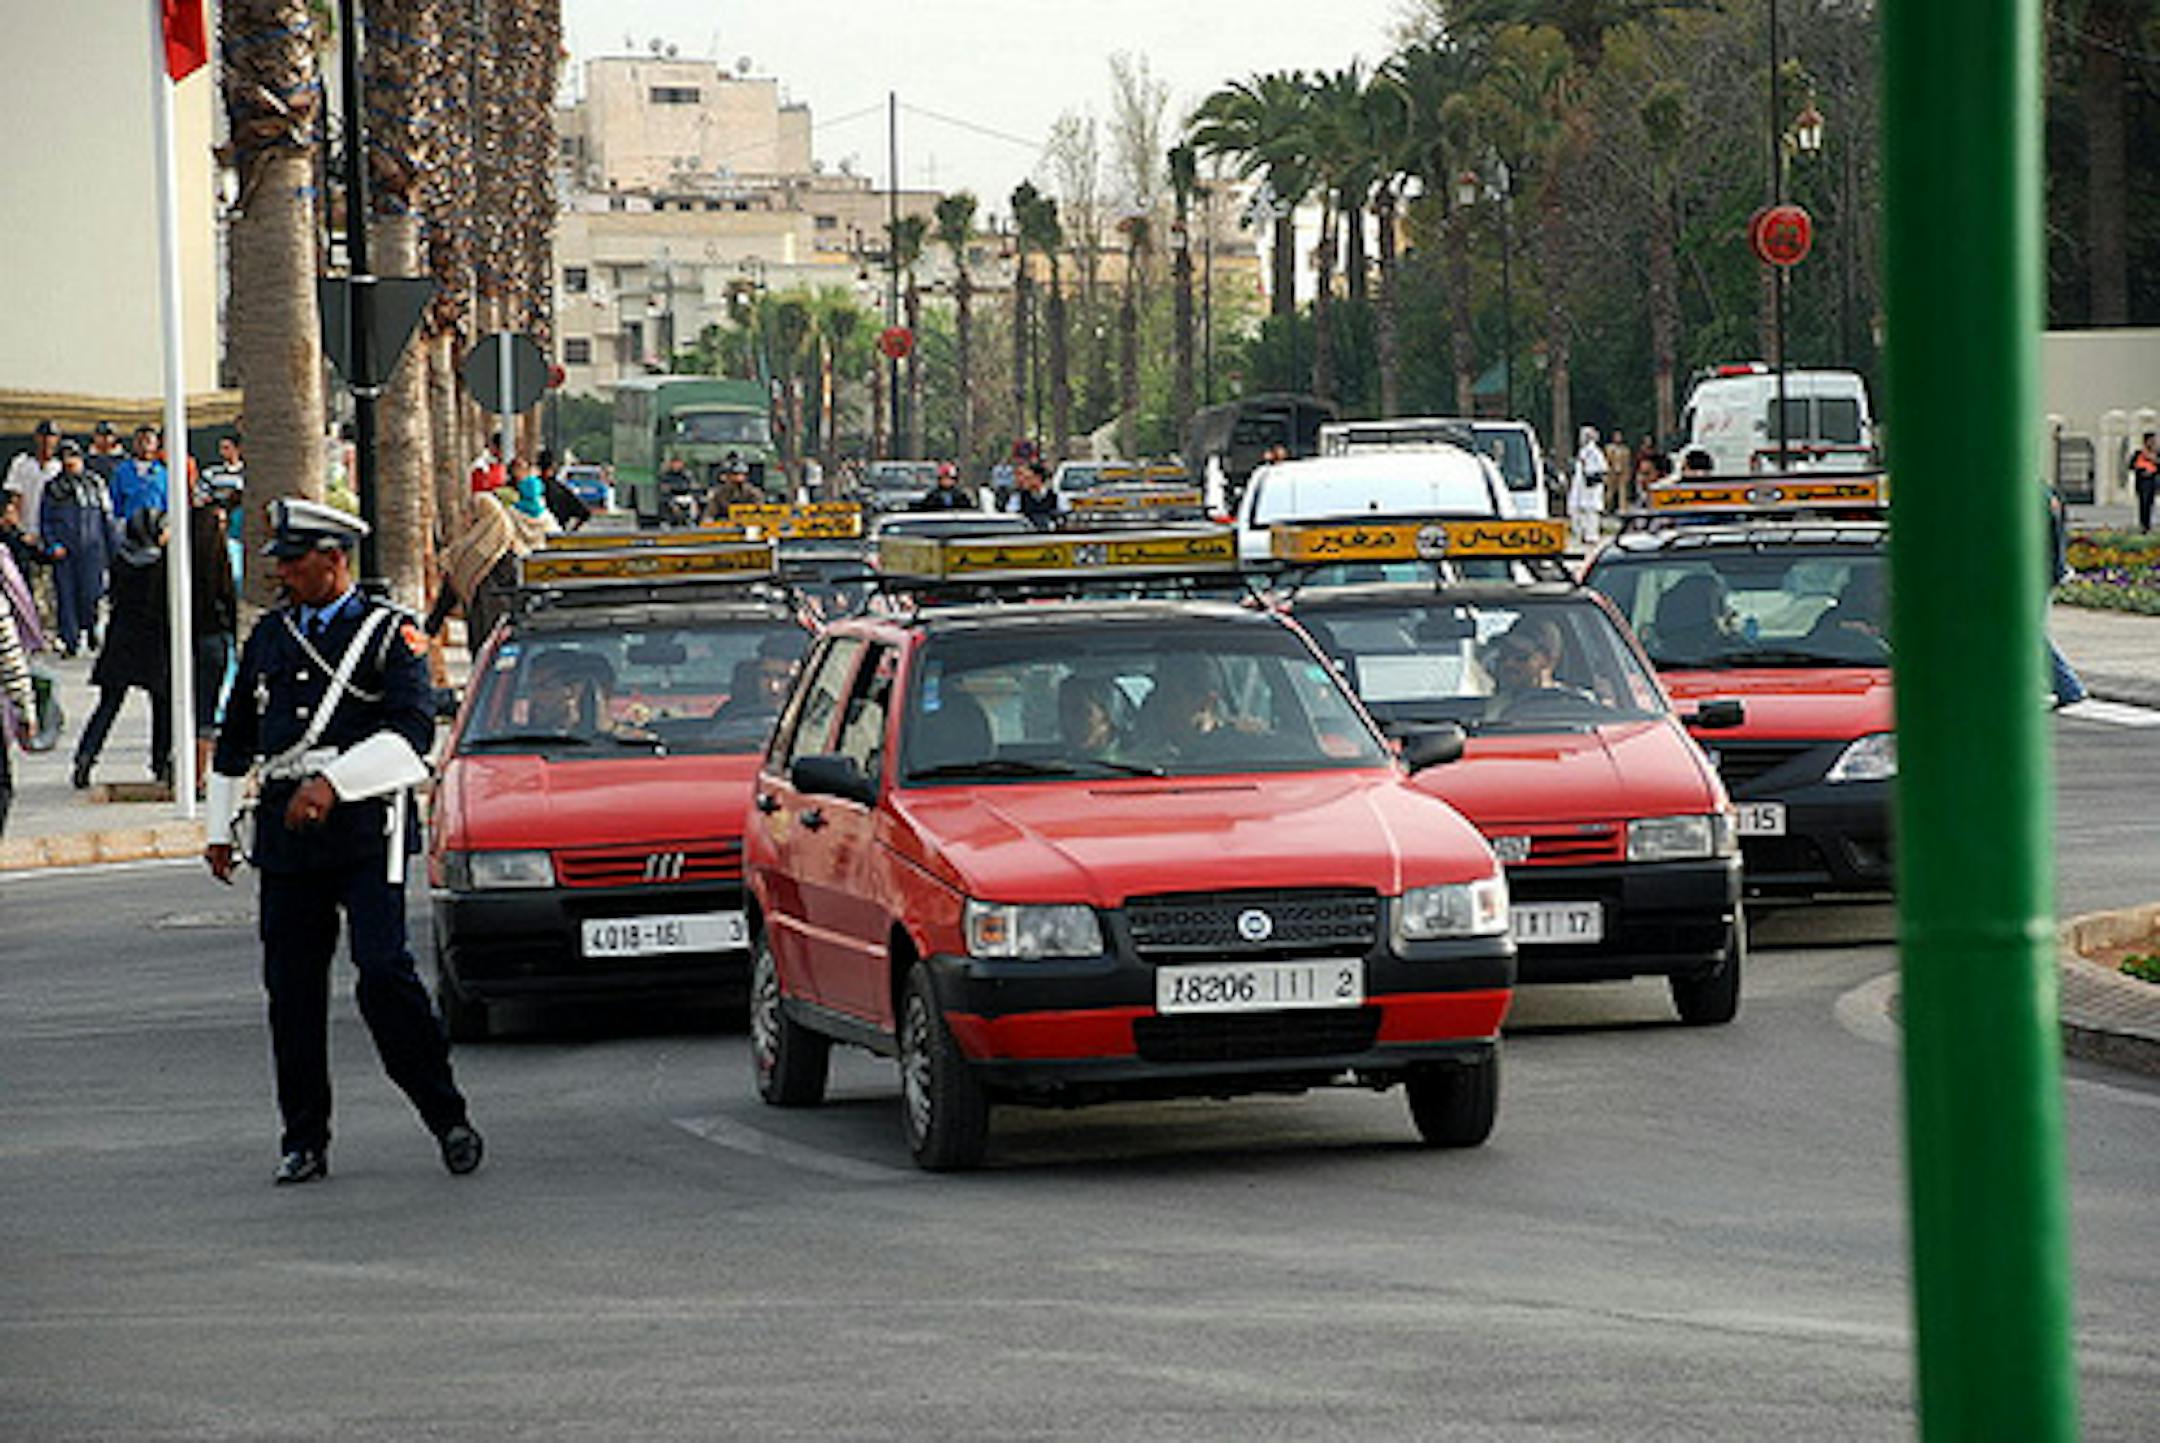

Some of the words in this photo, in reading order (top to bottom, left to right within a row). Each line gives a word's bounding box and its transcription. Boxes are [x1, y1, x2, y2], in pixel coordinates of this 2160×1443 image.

[1751, 807, 1776, 830] 15
[1568, 910, 1590, 934] 17
[1170, 970, 1255, 1005] 18206
[1334, 967, 1354, 998] 2
